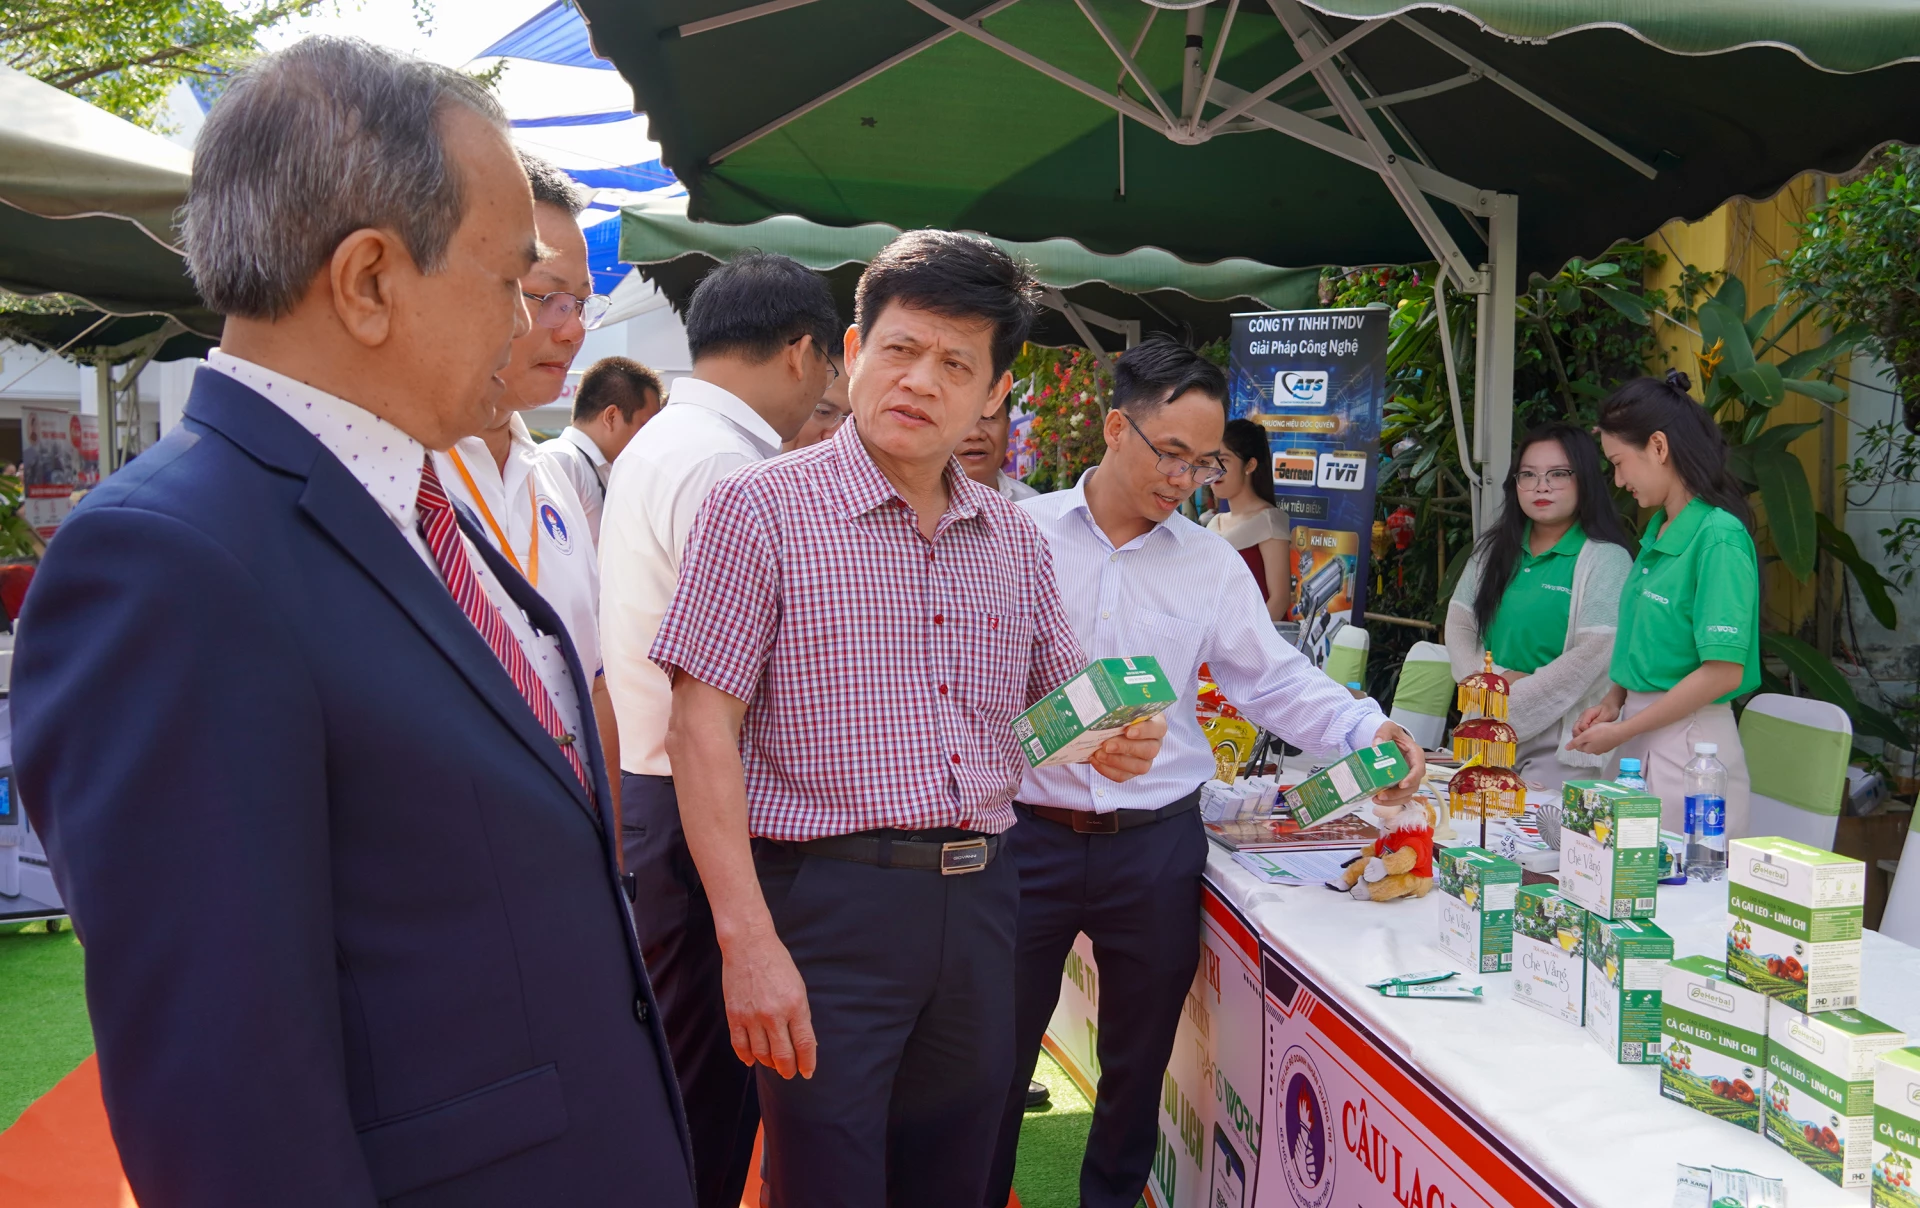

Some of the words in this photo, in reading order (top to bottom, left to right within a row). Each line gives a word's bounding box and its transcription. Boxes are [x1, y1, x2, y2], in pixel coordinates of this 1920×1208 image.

[1249, 316, 1280, 332] CÔNG
[1282, 318, 1294, 331] TY
[1298, 316, 1329, 331] TNHH
[1331, 315, 1365, 330] TMDV
[1249, 339, 1269, 355] Giải
[1271, 340, 1297, 357] Pháp
[1299, 340, 1327, 357] Công
[1329, 338, 1359, 356] Nghệ
[1292, 378, 1324, 391] ATS
[1275, 498, 1289, 511] HẨM
[1290, 500, 1305, 513] TIÊU
[1310, 533, 1323, 546] KHÍ
[1568, 847, 1581, 866] Chè
[1731, 896, 1740, 908] CÀ
[1742, 900, 1754, 913] GAI
[1755, 904, 1768, 918] LEO
[1774, 912, 1791, 926] LINH
[1793, 919, 1806, 931] CHI
[1523, 952, 1541, 972] Chè
[1201, 940, 1221, 1005] TRỊ
[1666, 1017, 1678, 1030] CÀ
[1679, 1022, 1694, 1035] GAI
[1695, 1028, 1711, 1041] LEO
[1719, 1036, 1739, 1051] LINH
[1741, 1043, 1757, 1057] CHI
[1770, 1055, 1779, 1067] CÀ
[1780, 1060, 1792, 1075] GAI
[1792, 1068, 1805, 1083] LEO
[1811, 1078, 1828, 1096] LINH
[1829, 1089, 1842, 1104] CHI
[1342, 1098, 1388, 1184] CÂU
[1879, 1122, 1894, 1138] CÀ
[1896, 1129, 1915, 1146] GAI
